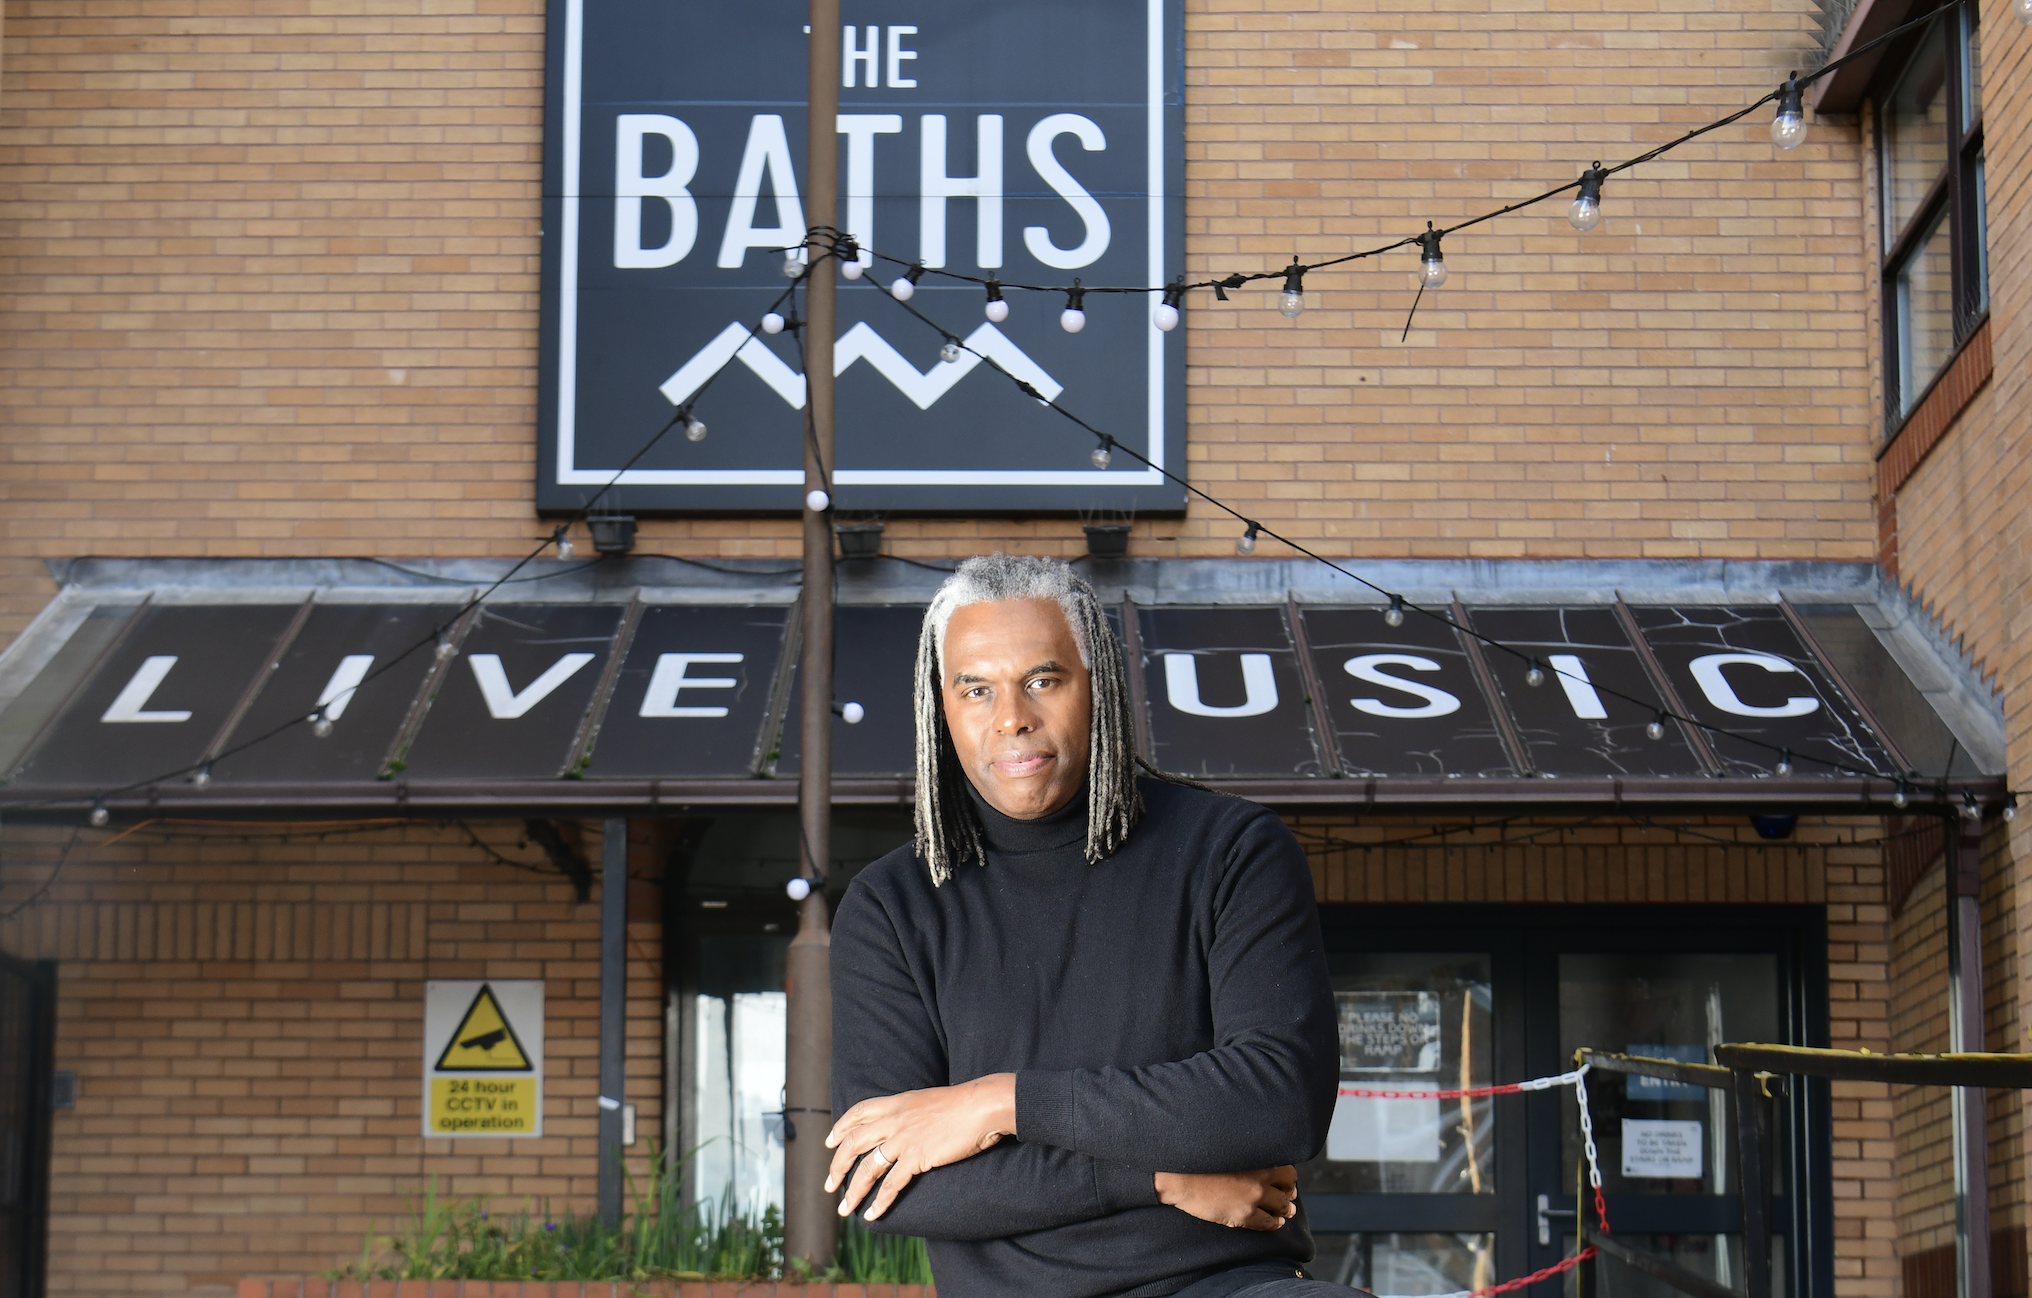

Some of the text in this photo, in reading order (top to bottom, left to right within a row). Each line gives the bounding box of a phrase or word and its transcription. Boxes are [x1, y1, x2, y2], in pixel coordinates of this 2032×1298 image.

[803, 25, 918, 88] HE
[613, 113, 1112, 270] BATHS
[101, 652, 1819, 723] LIVE USIC
[1348, 1011, 1419, 1023] PLEASE NO
[1338, 1023, 1385, 1033] DRINKS
[1367, 1033, 1408, 1045] STEPS
[1364, 1045, 1403, 1056] RAMP
[450, 1080, 517, 1093] 24 hour
[447, 1097, 519, 1111] CCTV in
[440, 1115, 524, 1131] operation
